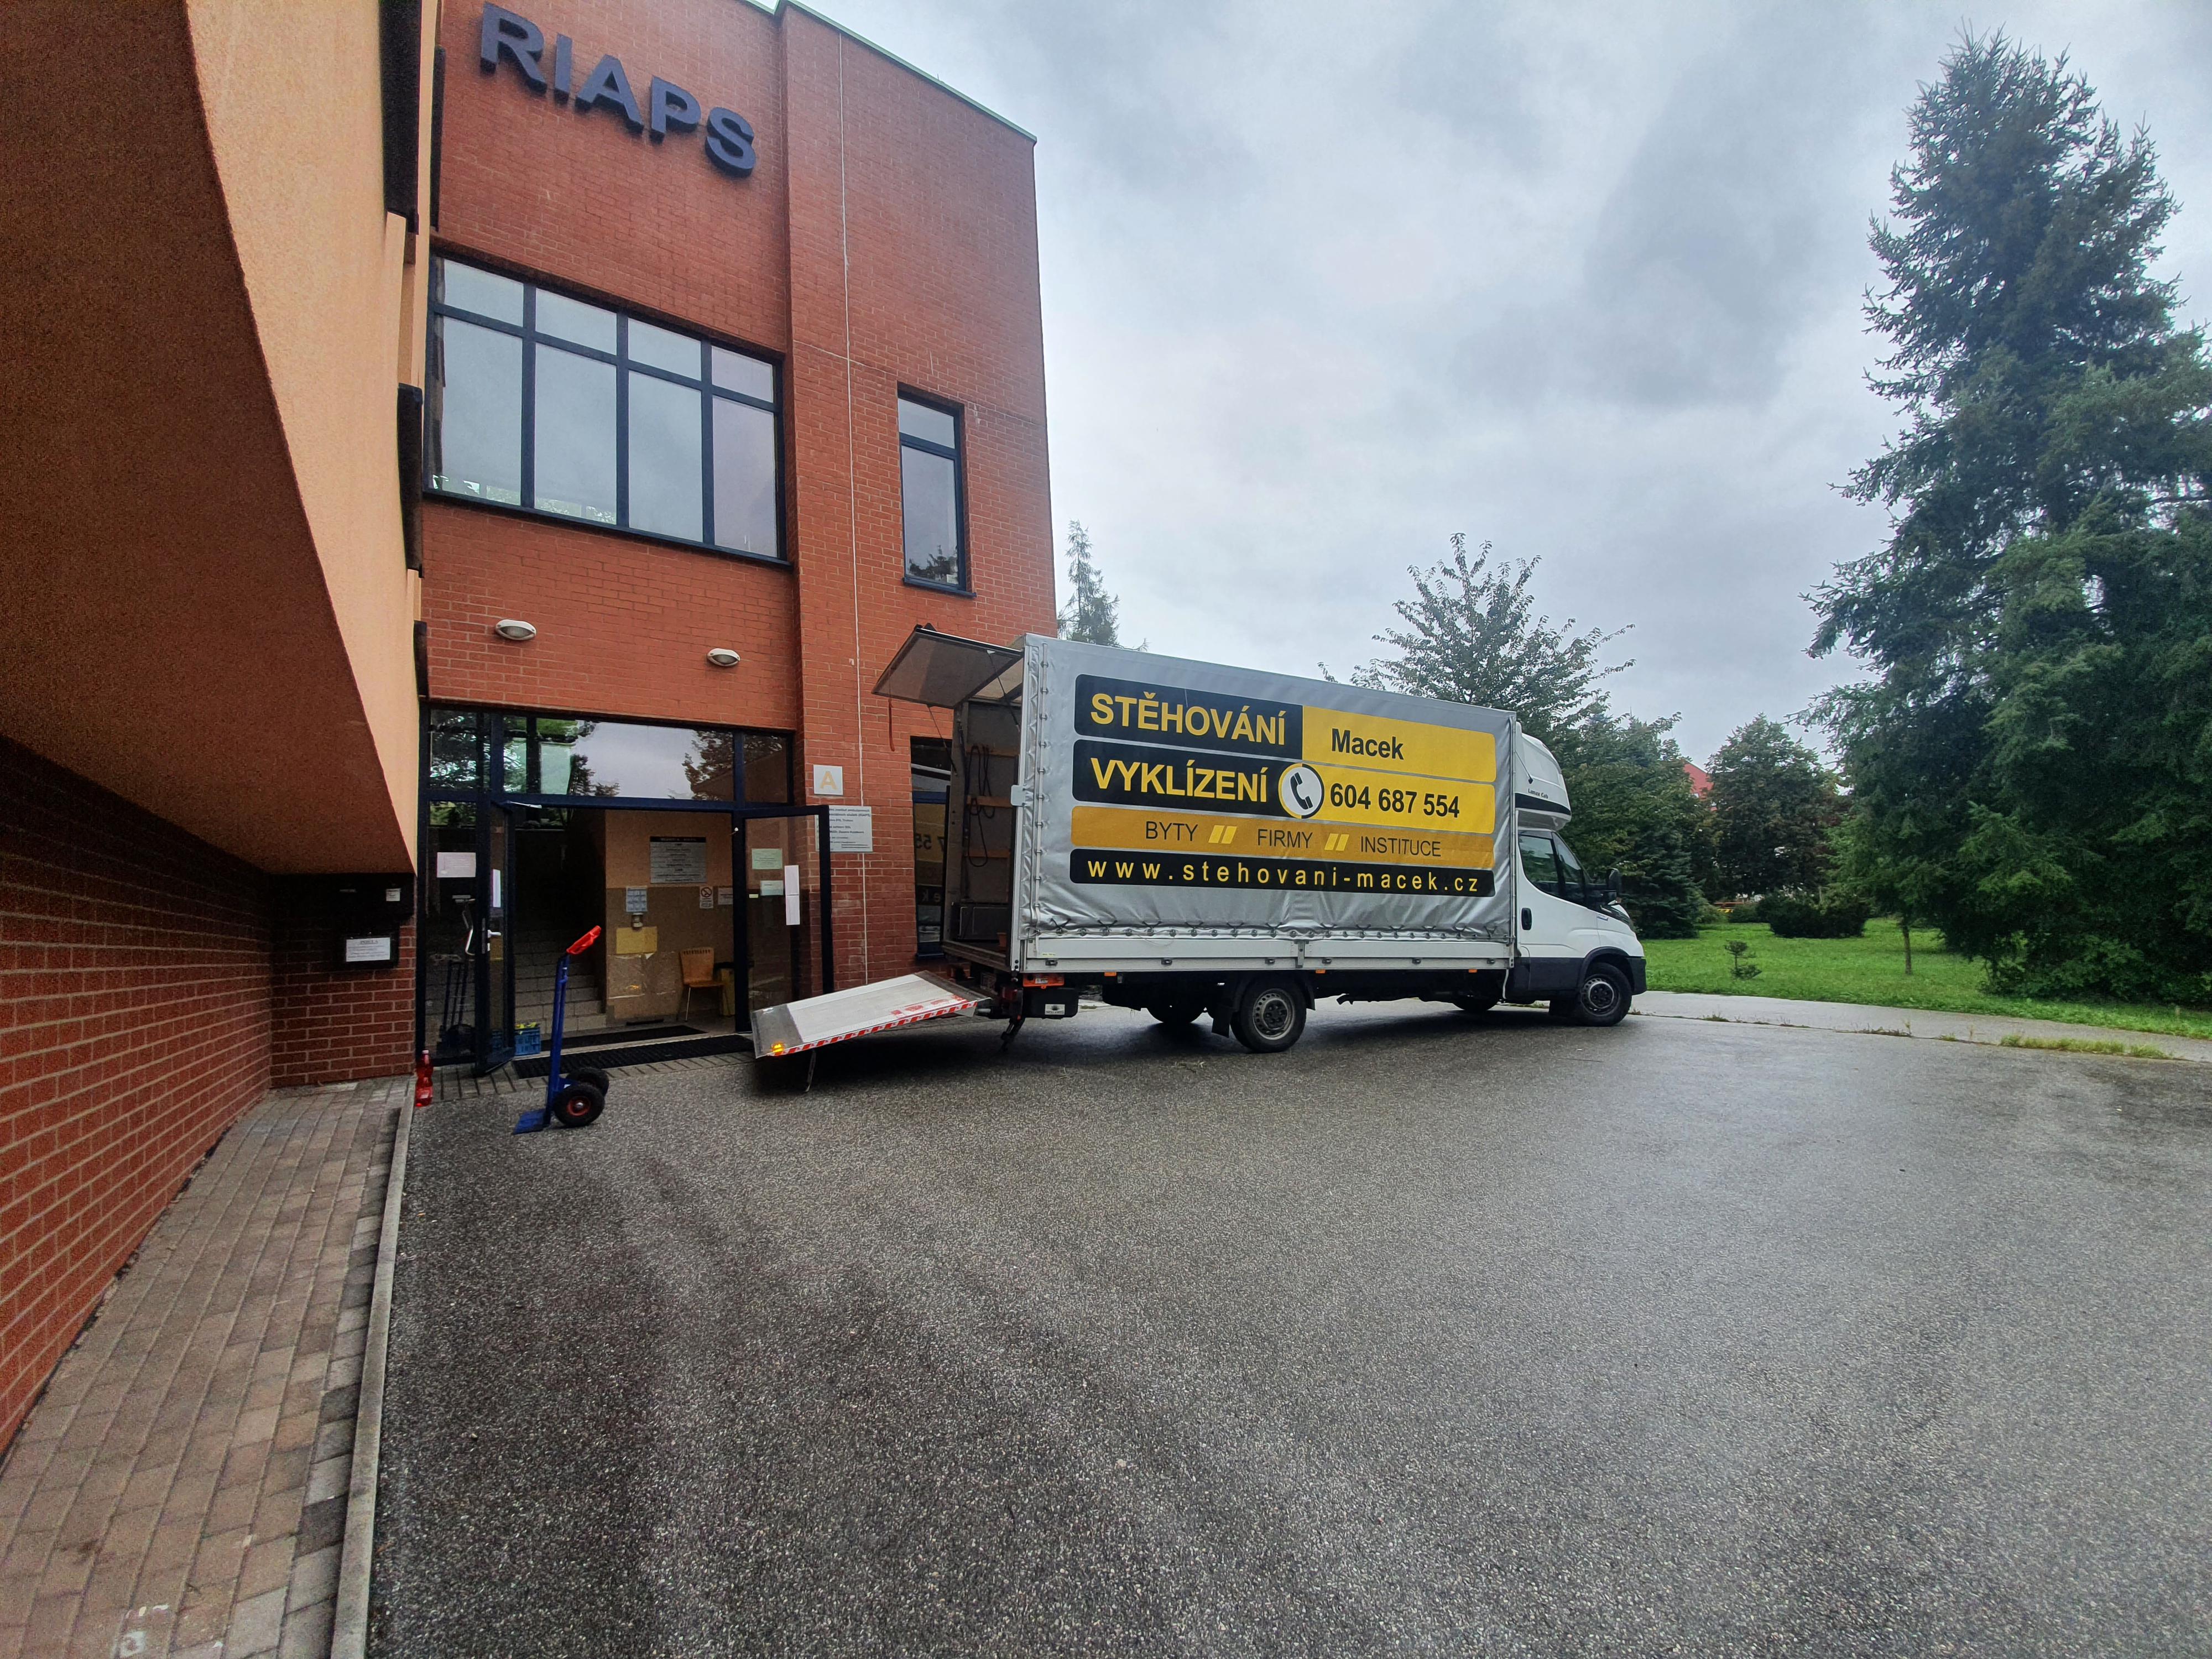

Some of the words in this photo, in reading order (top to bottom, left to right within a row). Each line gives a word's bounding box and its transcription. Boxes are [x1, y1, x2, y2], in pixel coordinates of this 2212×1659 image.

[480, 1, 756, 178] RIAPS
[1091, 692, 1286, 746] STĚHOVÁNÍ
[1331, 728, 1404, 760] Macek
[820, 770, 838, 790] A
[1090, 757, 1268, 803] VYKLÍZENÍ
[1330, 783, 1371, 810] 604
[1378, 787, 1416, 814] 687
[1423, 793, 1460, 818] 554
[1145, 820, 1199, 842] BYTY
[1257, 828, 1313, 849] FIRMY
[1360, 836, 1442, 858] INSTITUCE
[1087, 859, 1479, 893] www.stehovani-macek.cz
